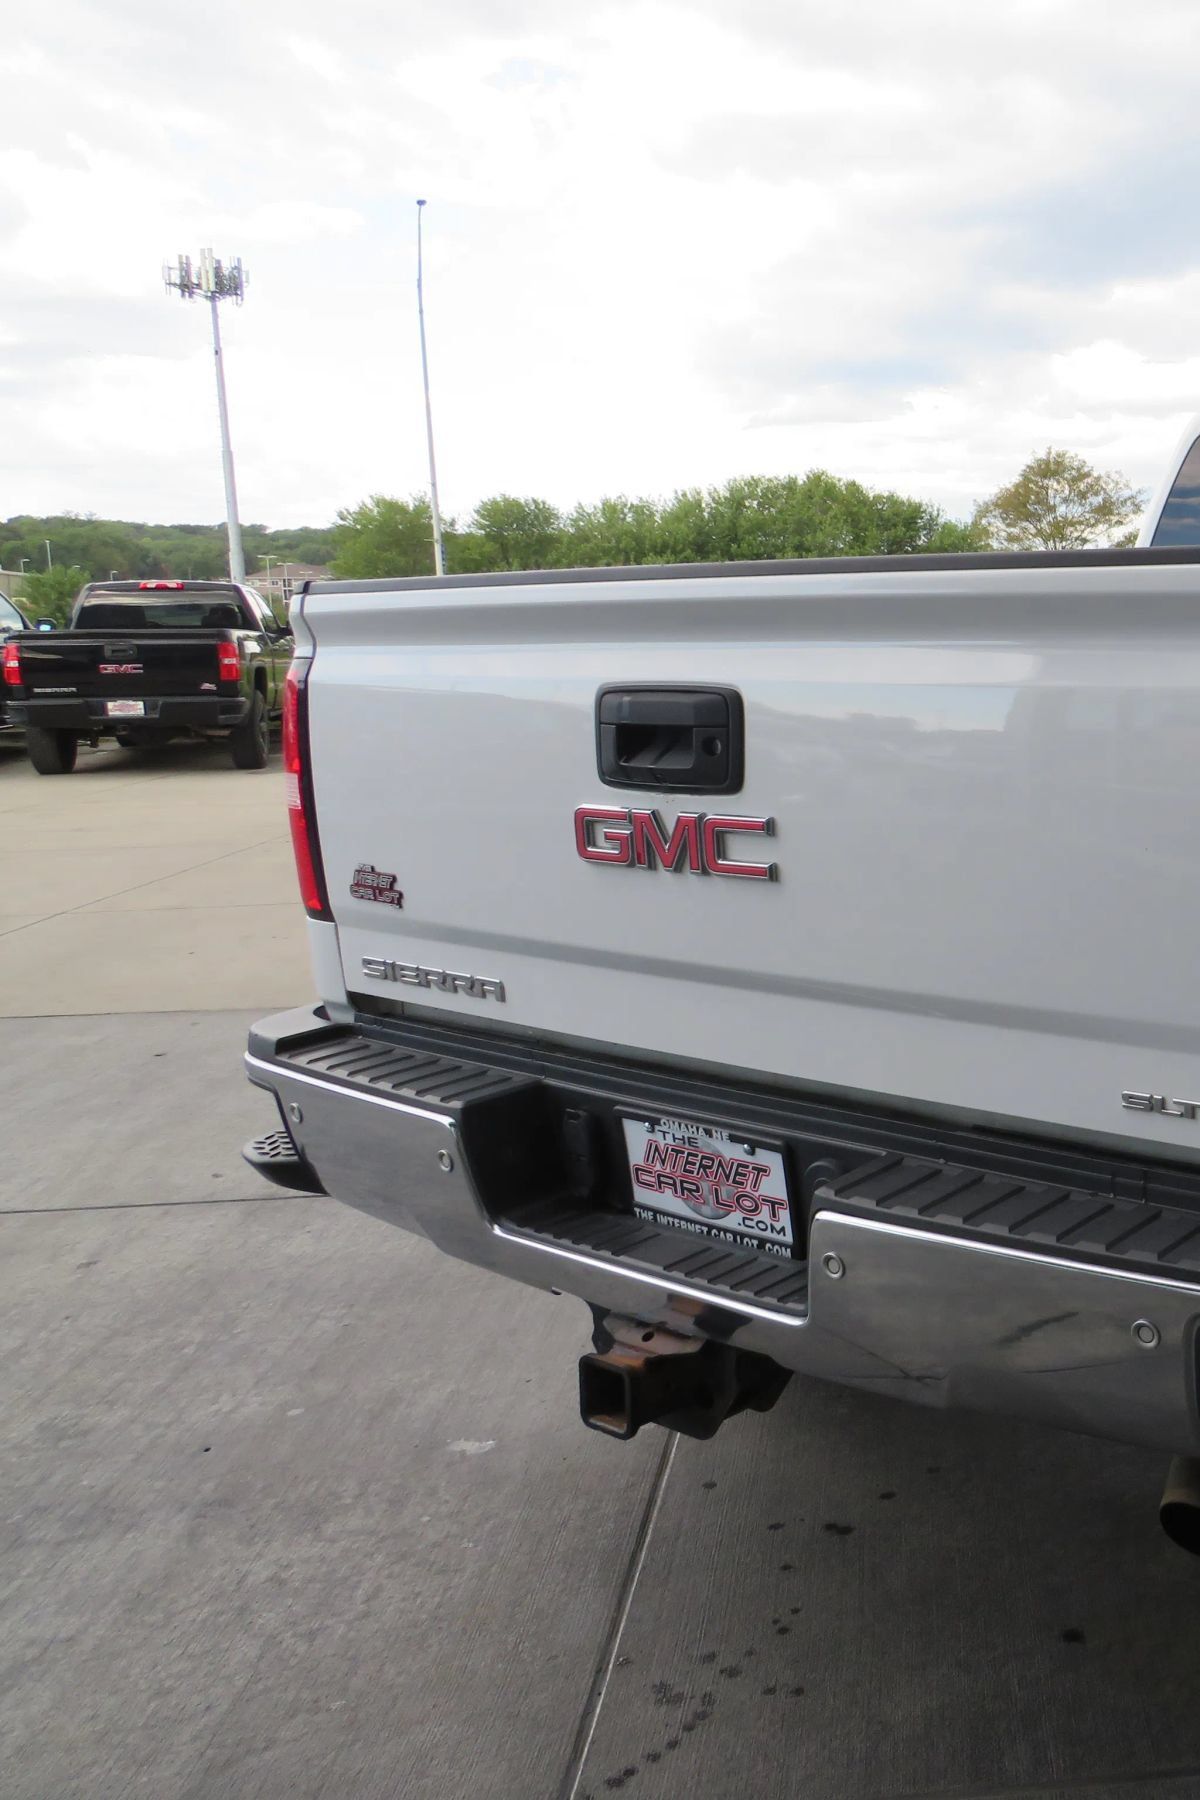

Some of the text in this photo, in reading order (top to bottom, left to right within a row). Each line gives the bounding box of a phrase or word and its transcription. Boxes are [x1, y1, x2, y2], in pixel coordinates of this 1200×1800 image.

[99, 664, 144, 673] GMC
[574, 803, 778, 882] GMC
[375, 889, 402, 904] LOT
[362, 956, 506, 1003] SIERRA
[657, 1129, 700, 1149] THE
[712, 1128, 731, 1142] NE
[644, 1139, 771, 1192] INTERNET
[633, 1164, 788, 1222] CAR LOT
[633, 1207, 655, 1222] THE
[656, 1213, 709, 1236] INTERNET
[711, 1228, 734, 1243] CAR
[738, 1216, 787, 1237] .COM
